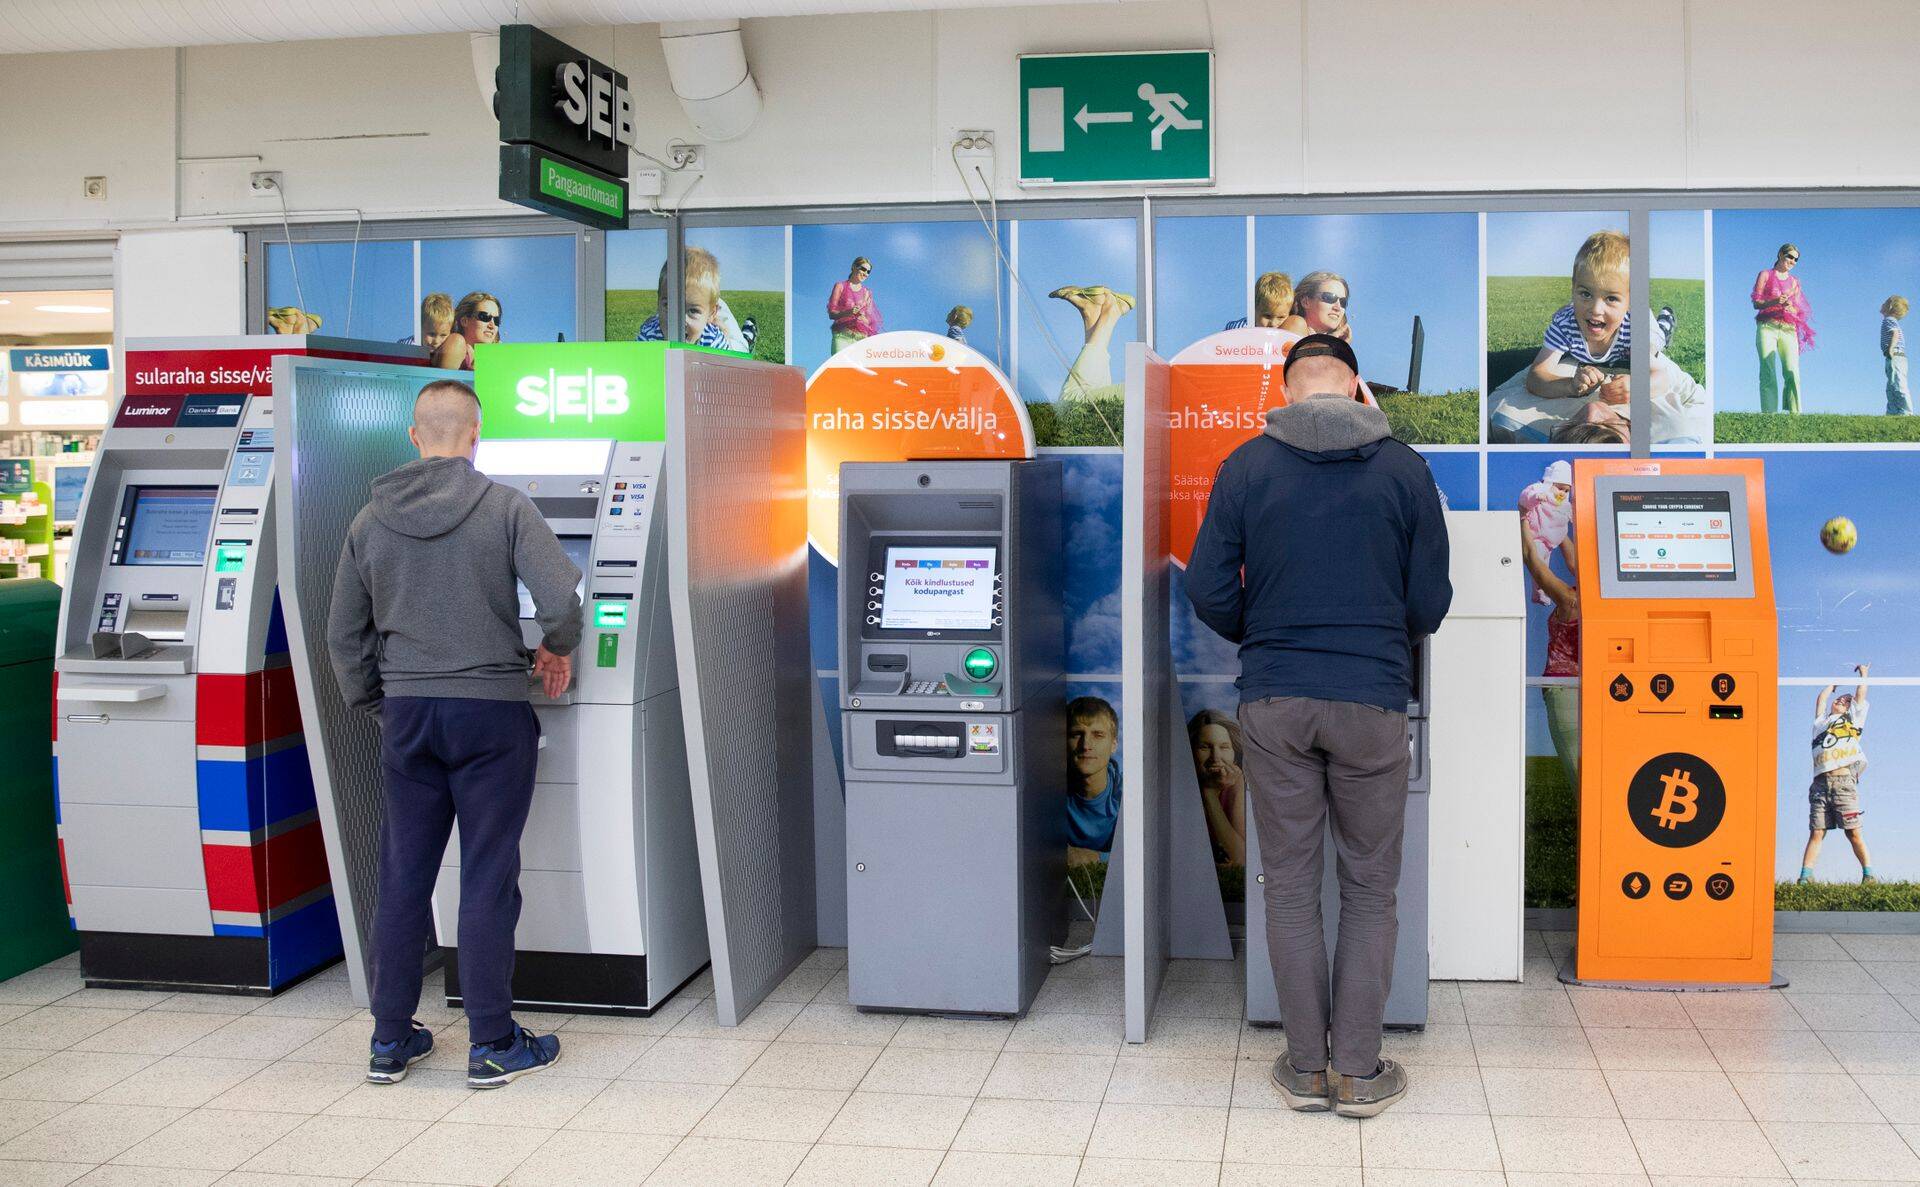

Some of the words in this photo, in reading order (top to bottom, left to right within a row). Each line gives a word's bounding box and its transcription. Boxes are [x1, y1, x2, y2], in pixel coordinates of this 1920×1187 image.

[548, 167, 619, 209] Pangaautomaat
[866, 348, 925, 358] Swedbank
[1215, 345, 1278, 356] Swedbak
[25, 352, 92, 367] KÄSIMÜÜK
[135, 367, 205, 385] sularaha
[124, 405, 171, 416] Luminor
[219, 406, 238, 414] Bank
[813, 408, 864, 430] raha
[872, 407, 997, 435] sisse/välja
[1174, 474, 1210, 486] Säästa
[905, 578, 922, 587] Kõik
[924, 578, 975, 587] kindlustused
[914, 587, 964, 596] kodupangast
